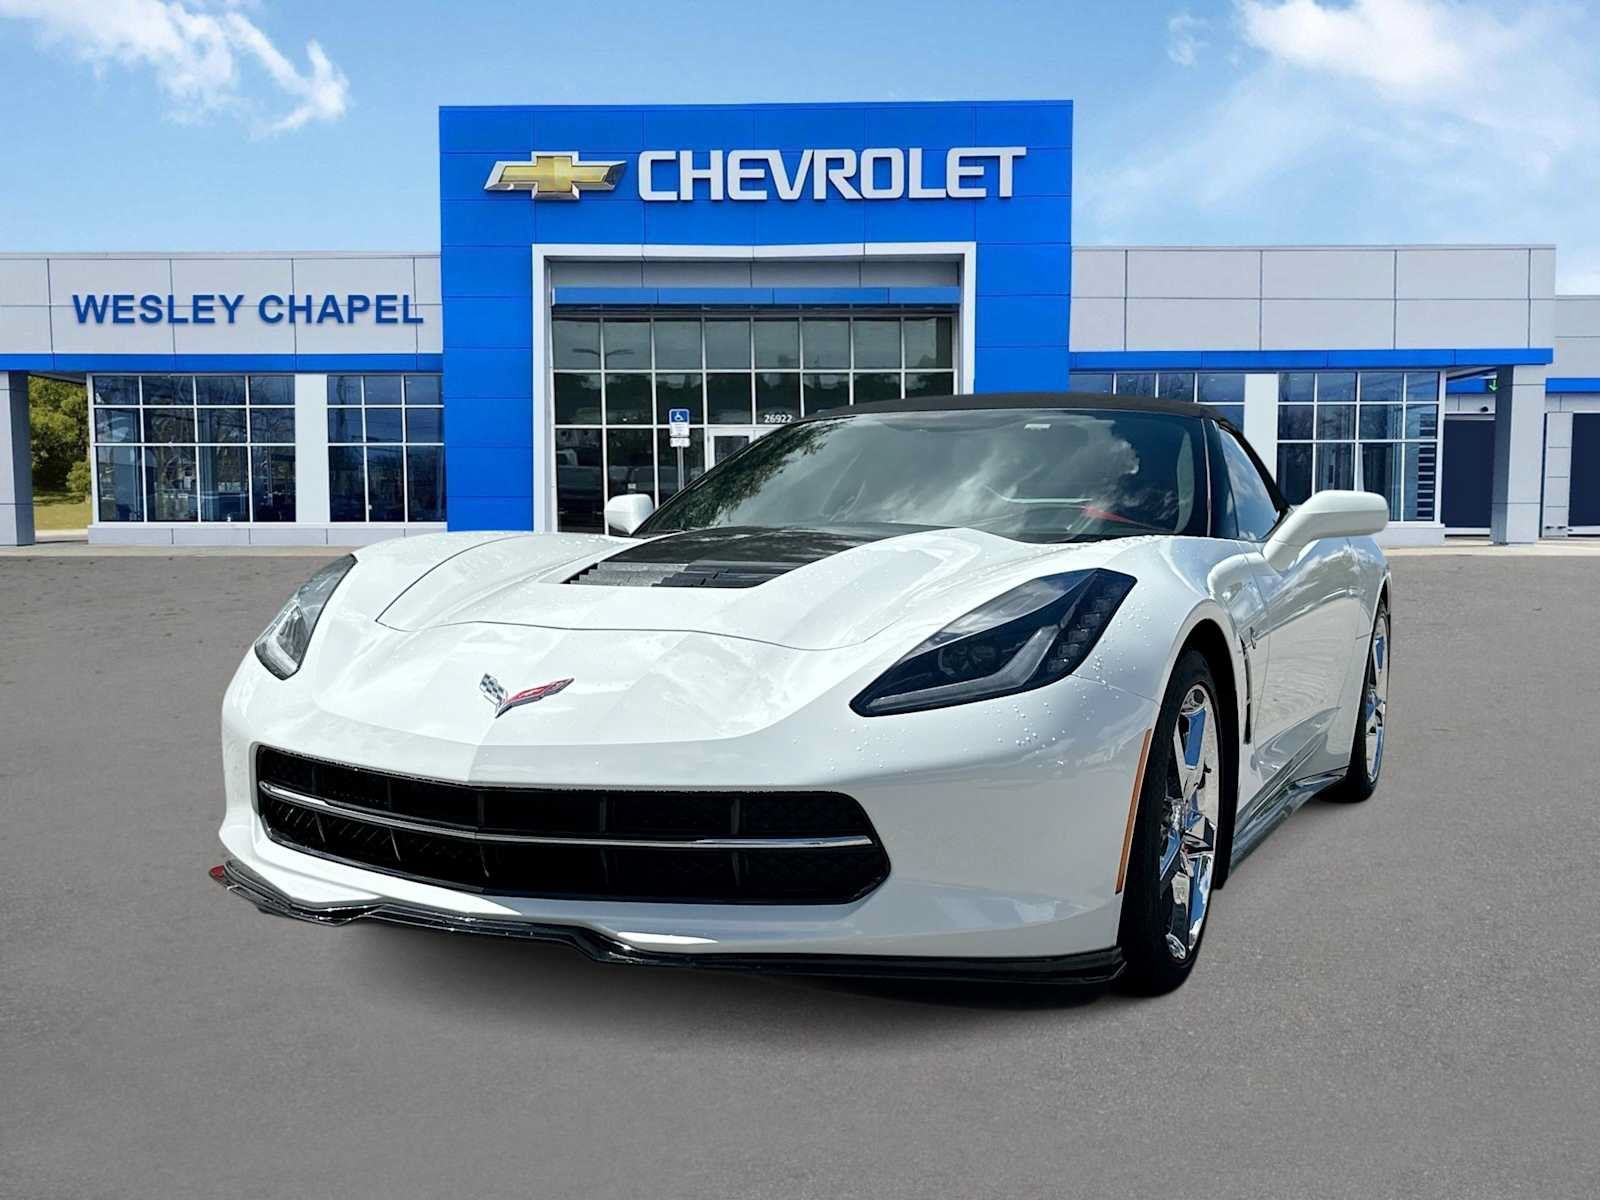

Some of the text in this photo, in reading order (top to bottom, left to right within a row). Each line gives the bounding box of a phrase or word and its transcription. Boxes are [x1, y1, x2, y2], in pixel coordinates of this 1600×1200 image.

[637, 146, 1027, 202] CHEVROLET
[72, 293, 424, 325] WESLEY CHAPEL
[763, 413, 793, 424] 26922
